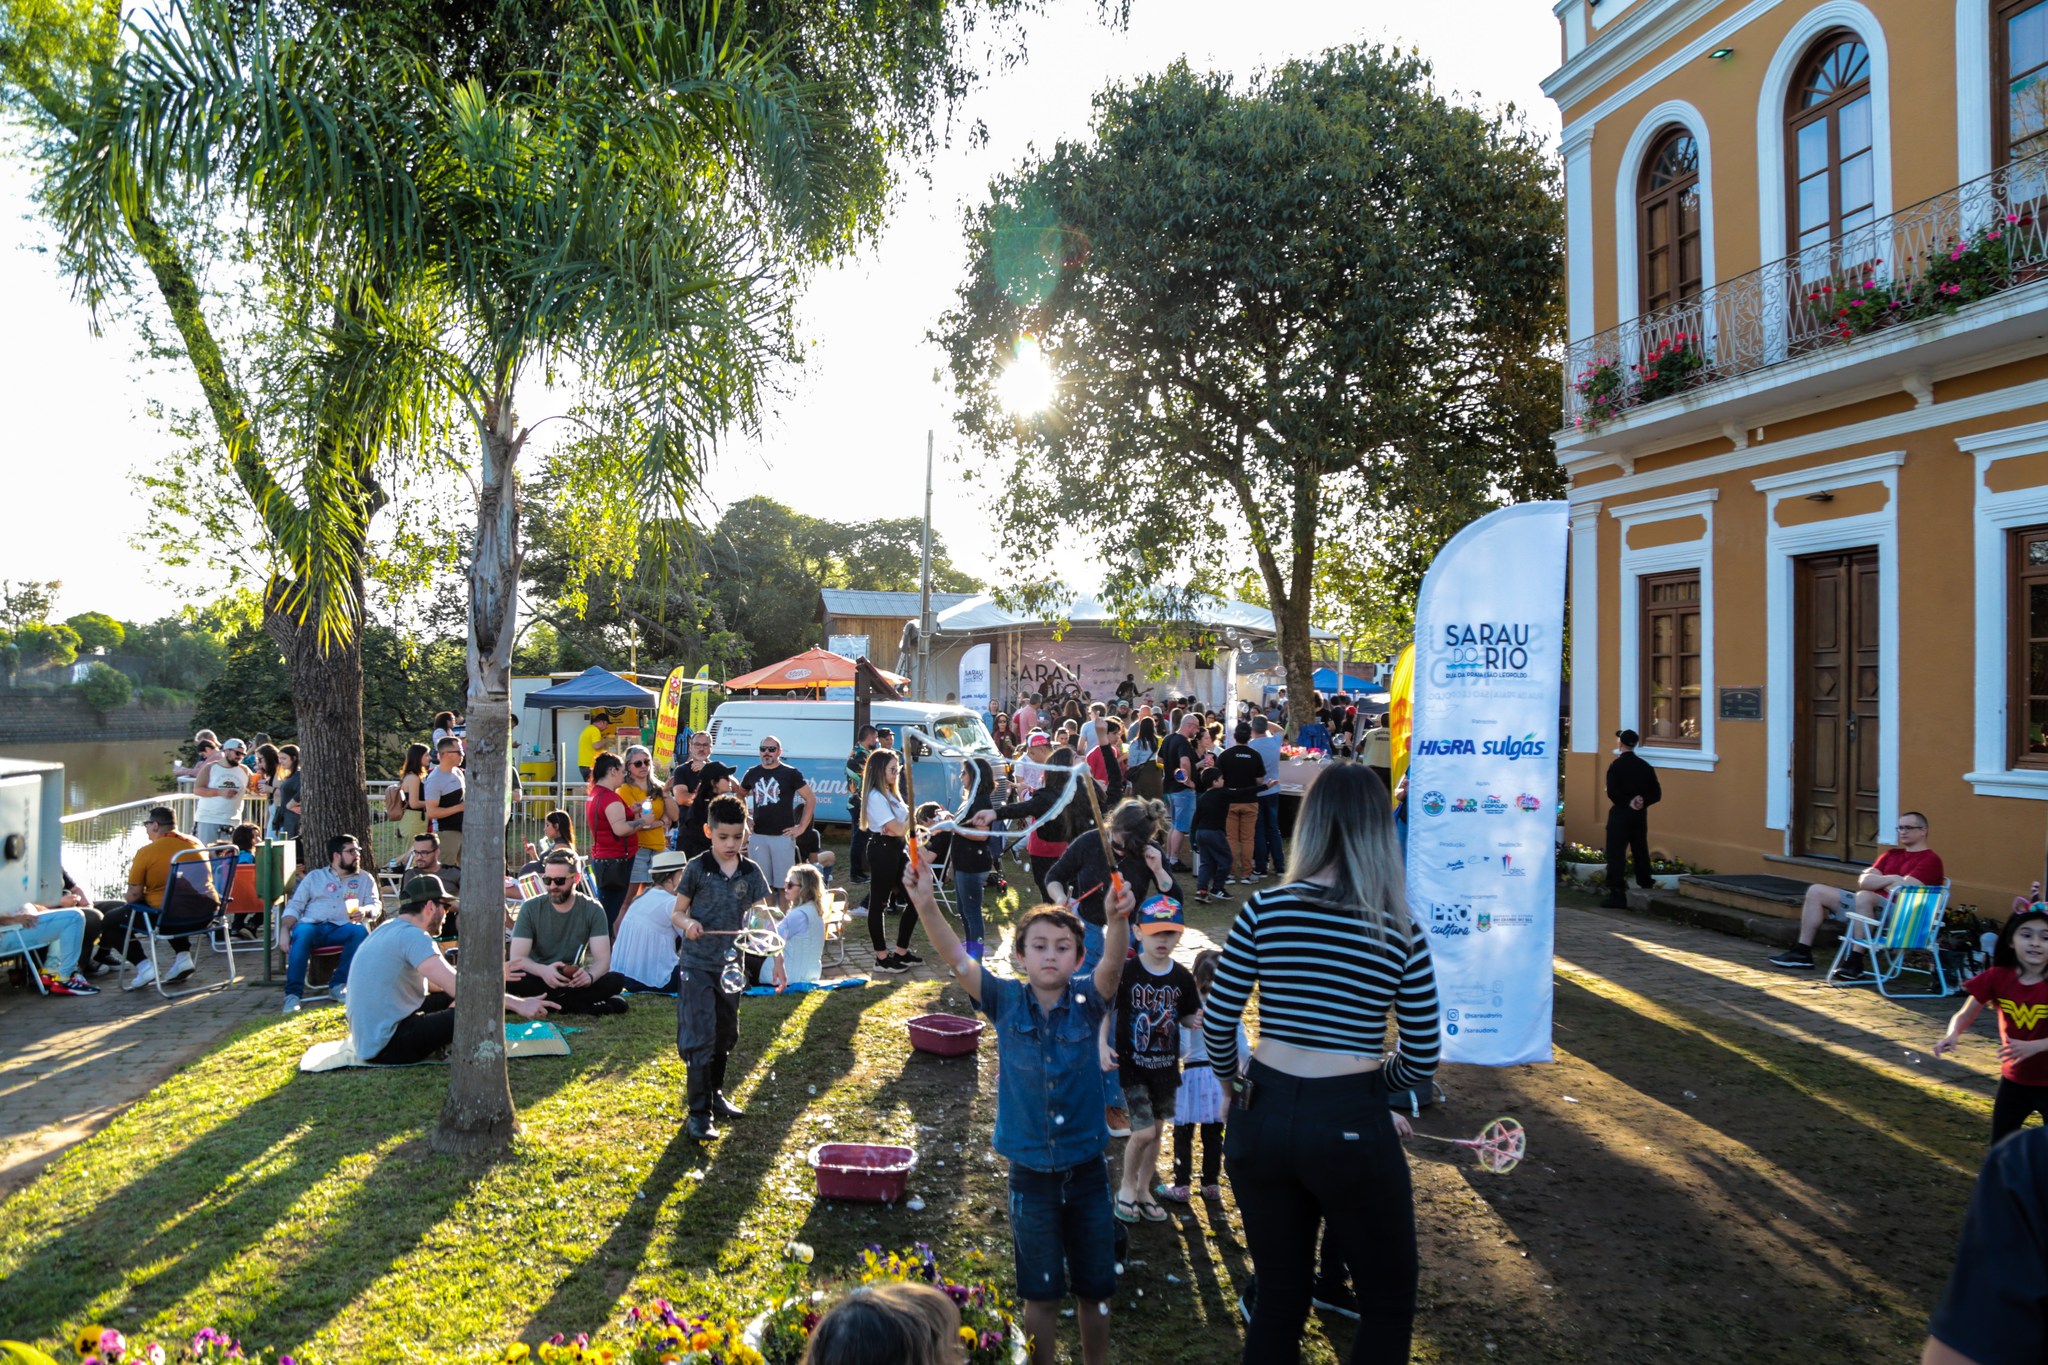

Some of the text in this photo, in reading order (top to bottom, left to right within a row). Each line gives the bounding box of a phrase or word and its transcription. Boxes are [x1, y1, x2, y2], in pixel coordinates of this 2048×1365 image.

[1446, 623, 1529, 647] SARAU
[1453, 647, 1528, 670] DO RIO
[1418, 733, 1546, 761] HIGRA sulgás
[755, 776, 780, 807] NY
[1430, 923, 1471, 938] cultura
